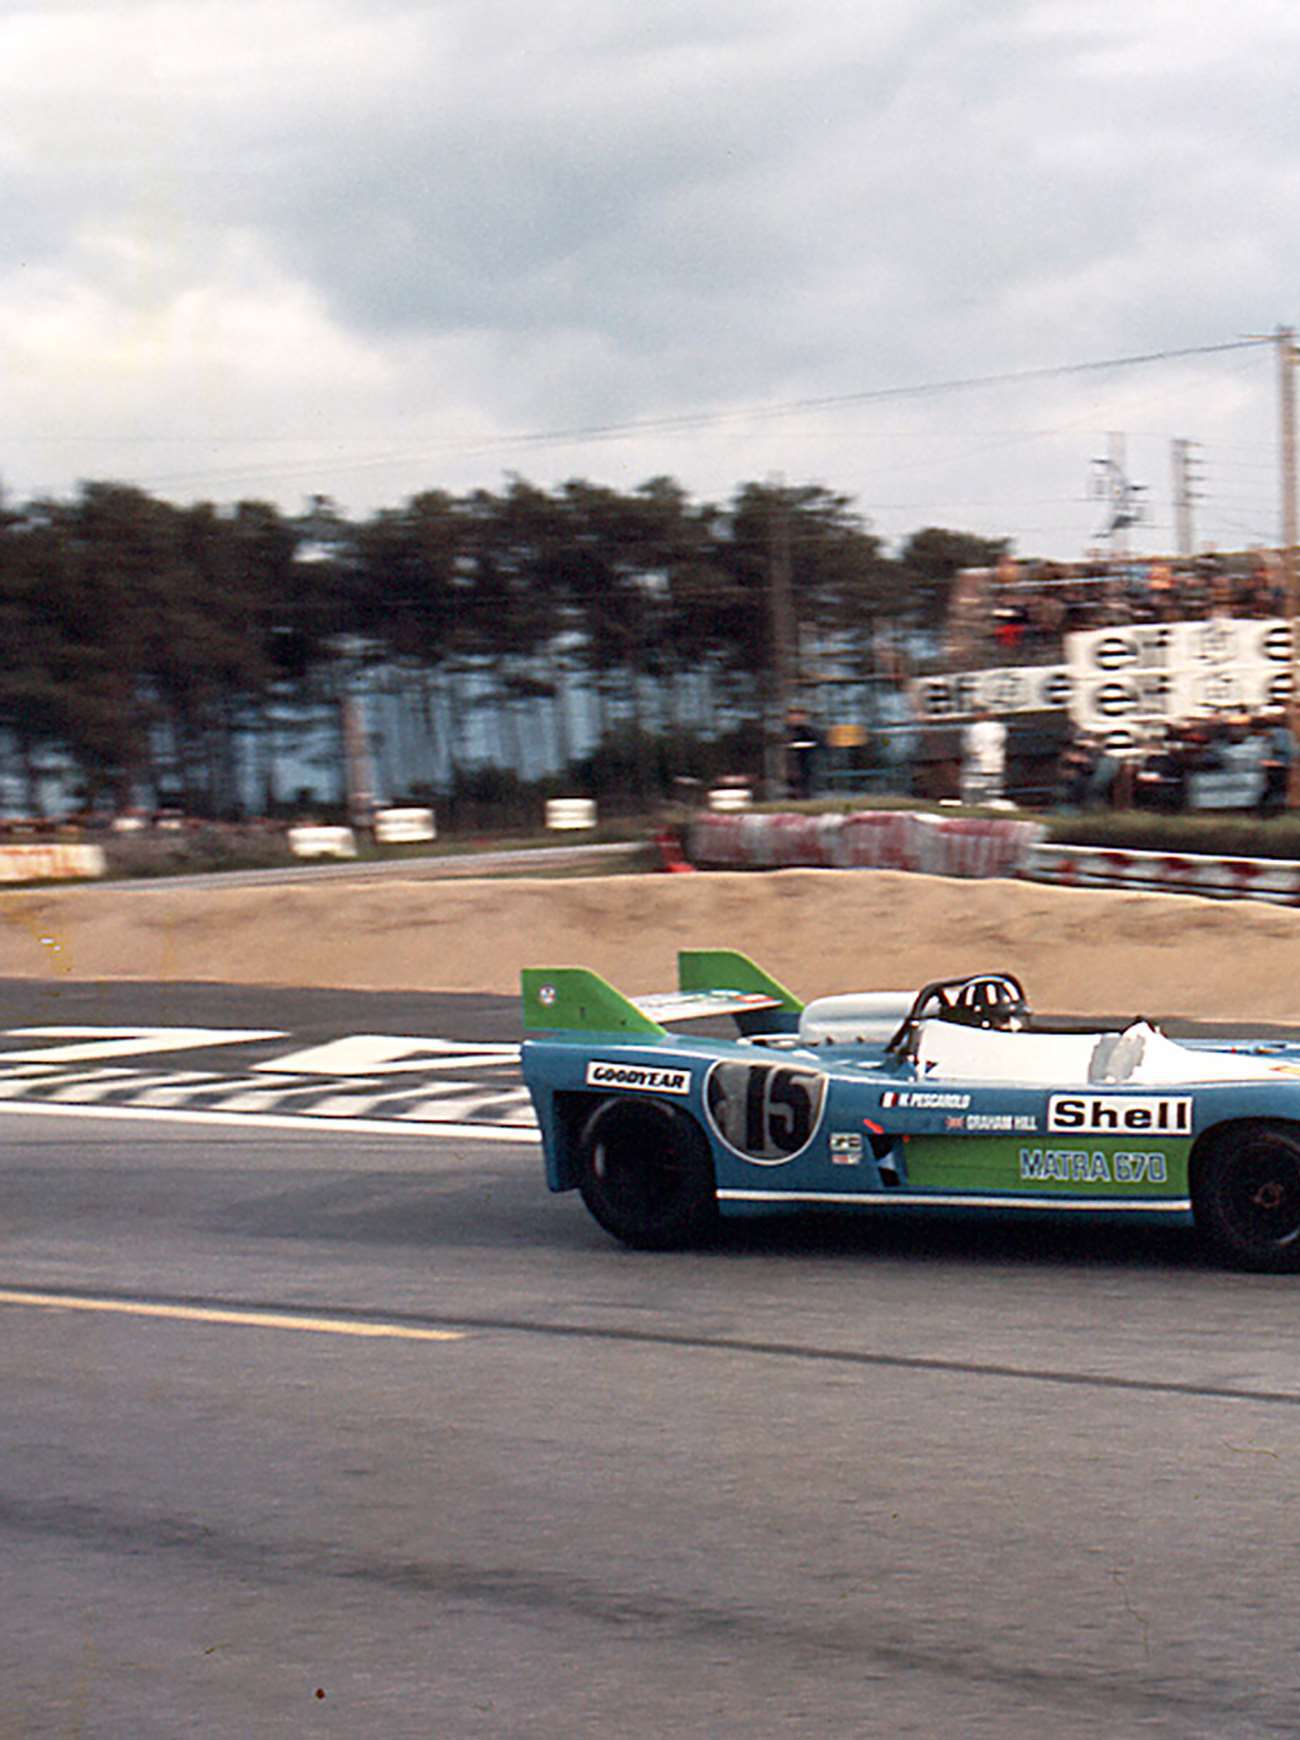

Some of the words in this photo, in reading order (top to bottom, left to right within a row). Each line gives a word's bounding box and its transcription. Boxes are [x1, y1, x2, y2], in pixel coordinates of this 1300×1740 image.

[592, 1066, 685, 1089] GOODYEAR
[744, 1064, 813, 1152] 15
[1053, 1100, 1187, 1130] Shell
[1020, 1147, 1112, 1183] MATRA
[1113, 1150, 1169, 1183] 670
